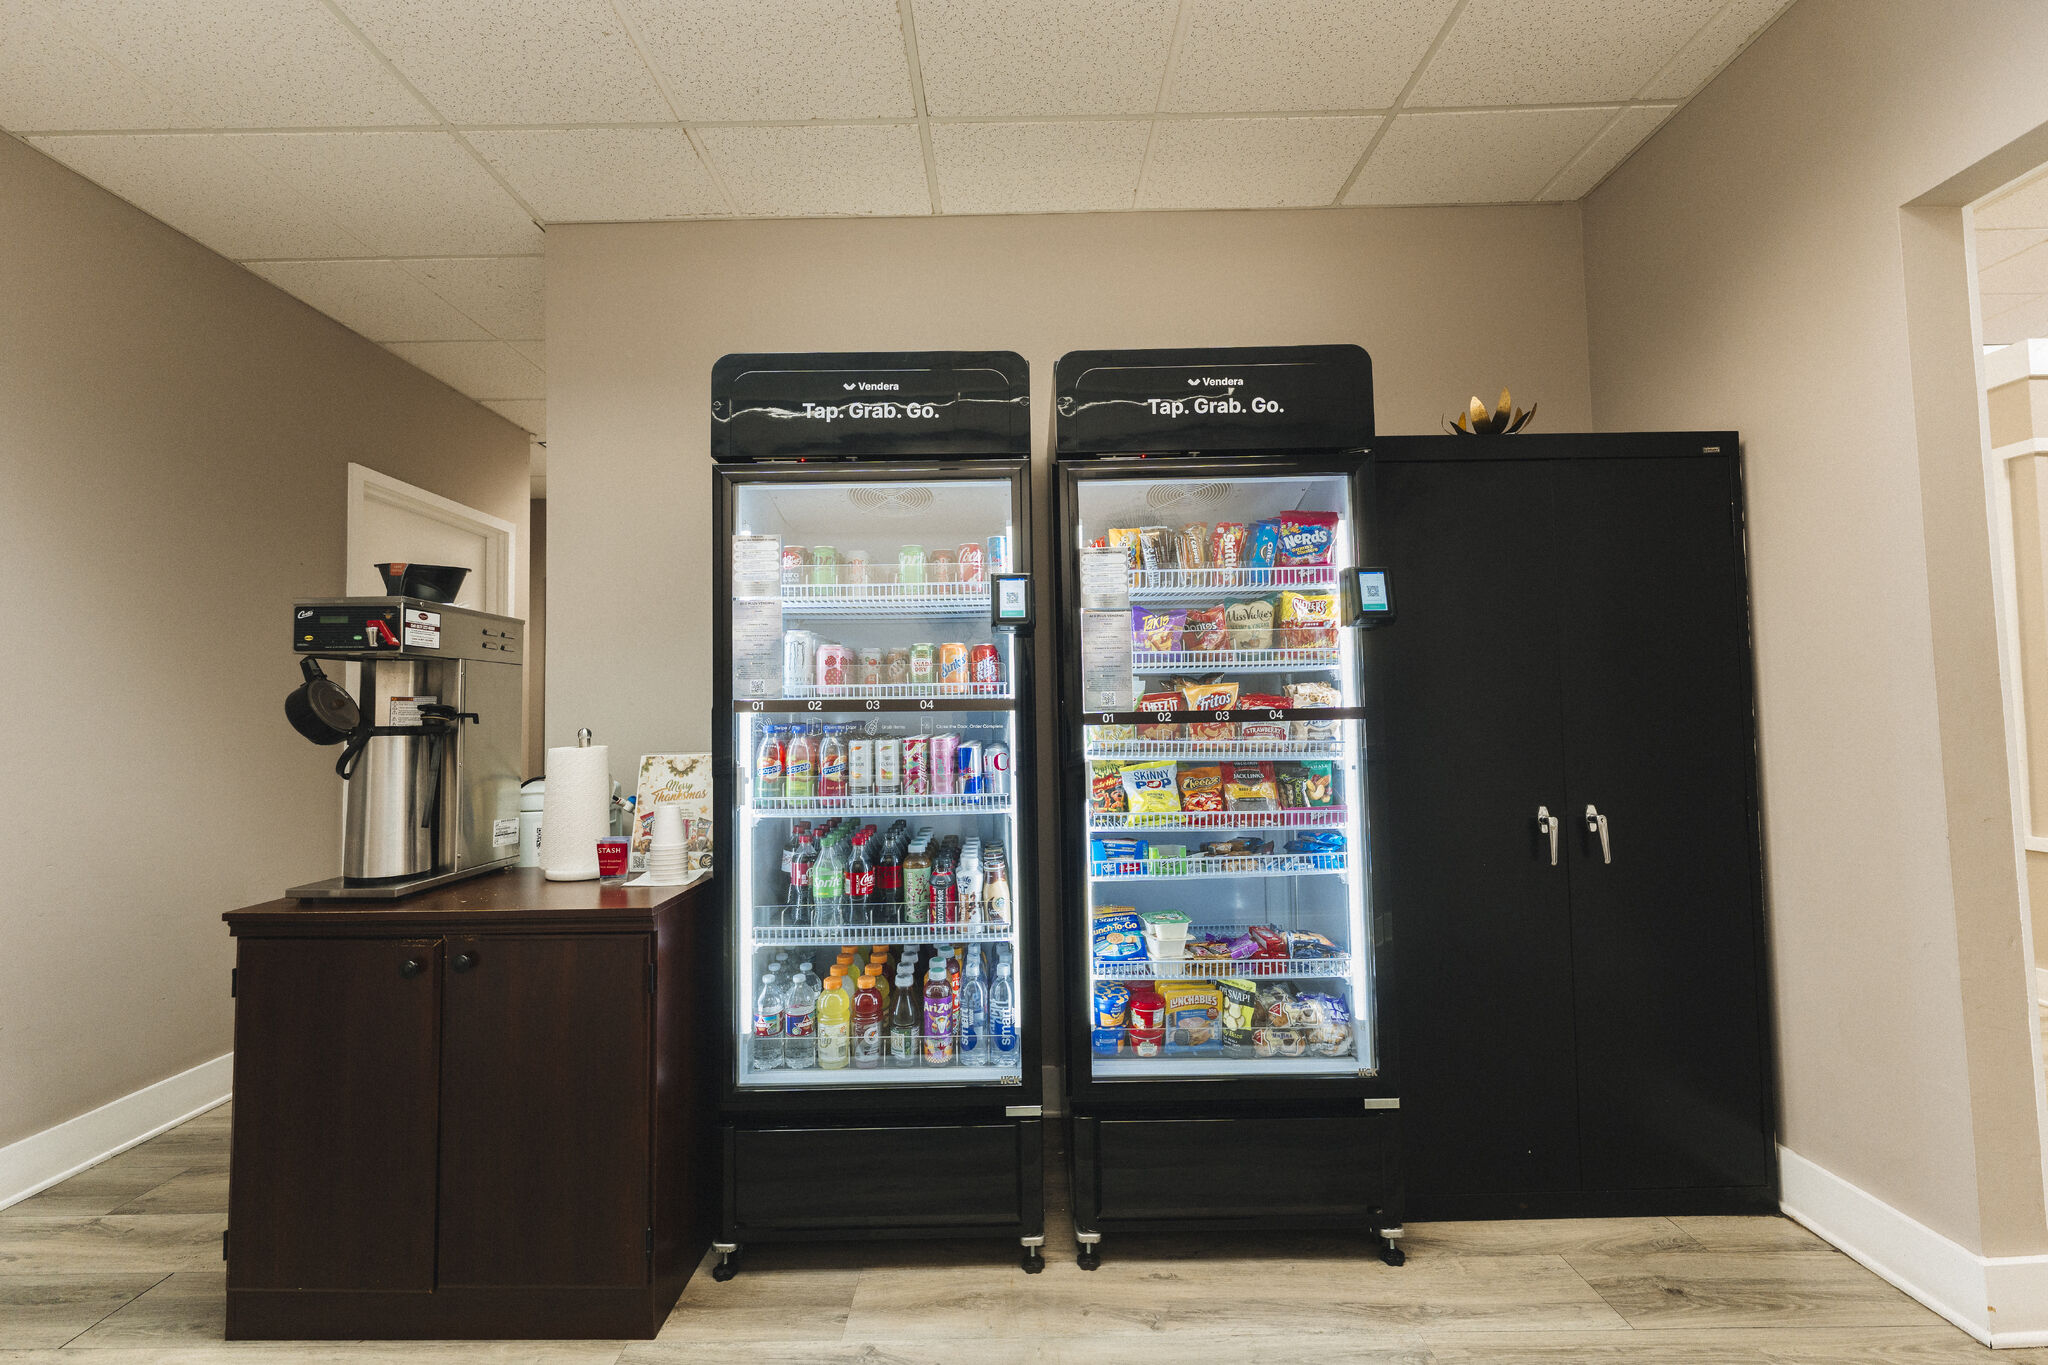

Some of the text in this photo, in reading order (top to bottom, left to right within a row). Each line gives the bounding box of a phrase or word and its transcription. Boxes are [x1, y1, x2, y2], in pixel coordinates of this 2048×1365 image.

[858, 382, 899, 391] Vendera
[1202, 377, 1244, 386] Vendera
[802, 402, 939, 422] Tap. Grab. Go.
[1148, 397, 1284, 418] Tap. Grab. Go.
[1142, 615, 1170, 632] Takis
[752, 701, 764, 711] 01
[808, 700, 822, 711] 02
[866, 700, 880, 710] 03
[919, 700, 934, 710] 04
[1102, 713, 1114, 723] 01
[1157, 712, 1172, 722] 02
[1215, 711, 1230, 720] 03
[1269, 710, 1283, 719] 04
[665, 779, 693, 793] Merry
[1135, 778, 1172, 790] POP
[1182, 776, 1220, 790] Cheetos
[651, 787, 708, 805] Thanksmas
[1093, 921, 1138, 935] unch-To-Go
[1170, 994, 1218, 1009] LUNCHABLES
[1227, 989, 1251, 1003] SNAP!
[961, 1008, 969, 1046] smart
[1001, 1007, 1011, 1046] smart
